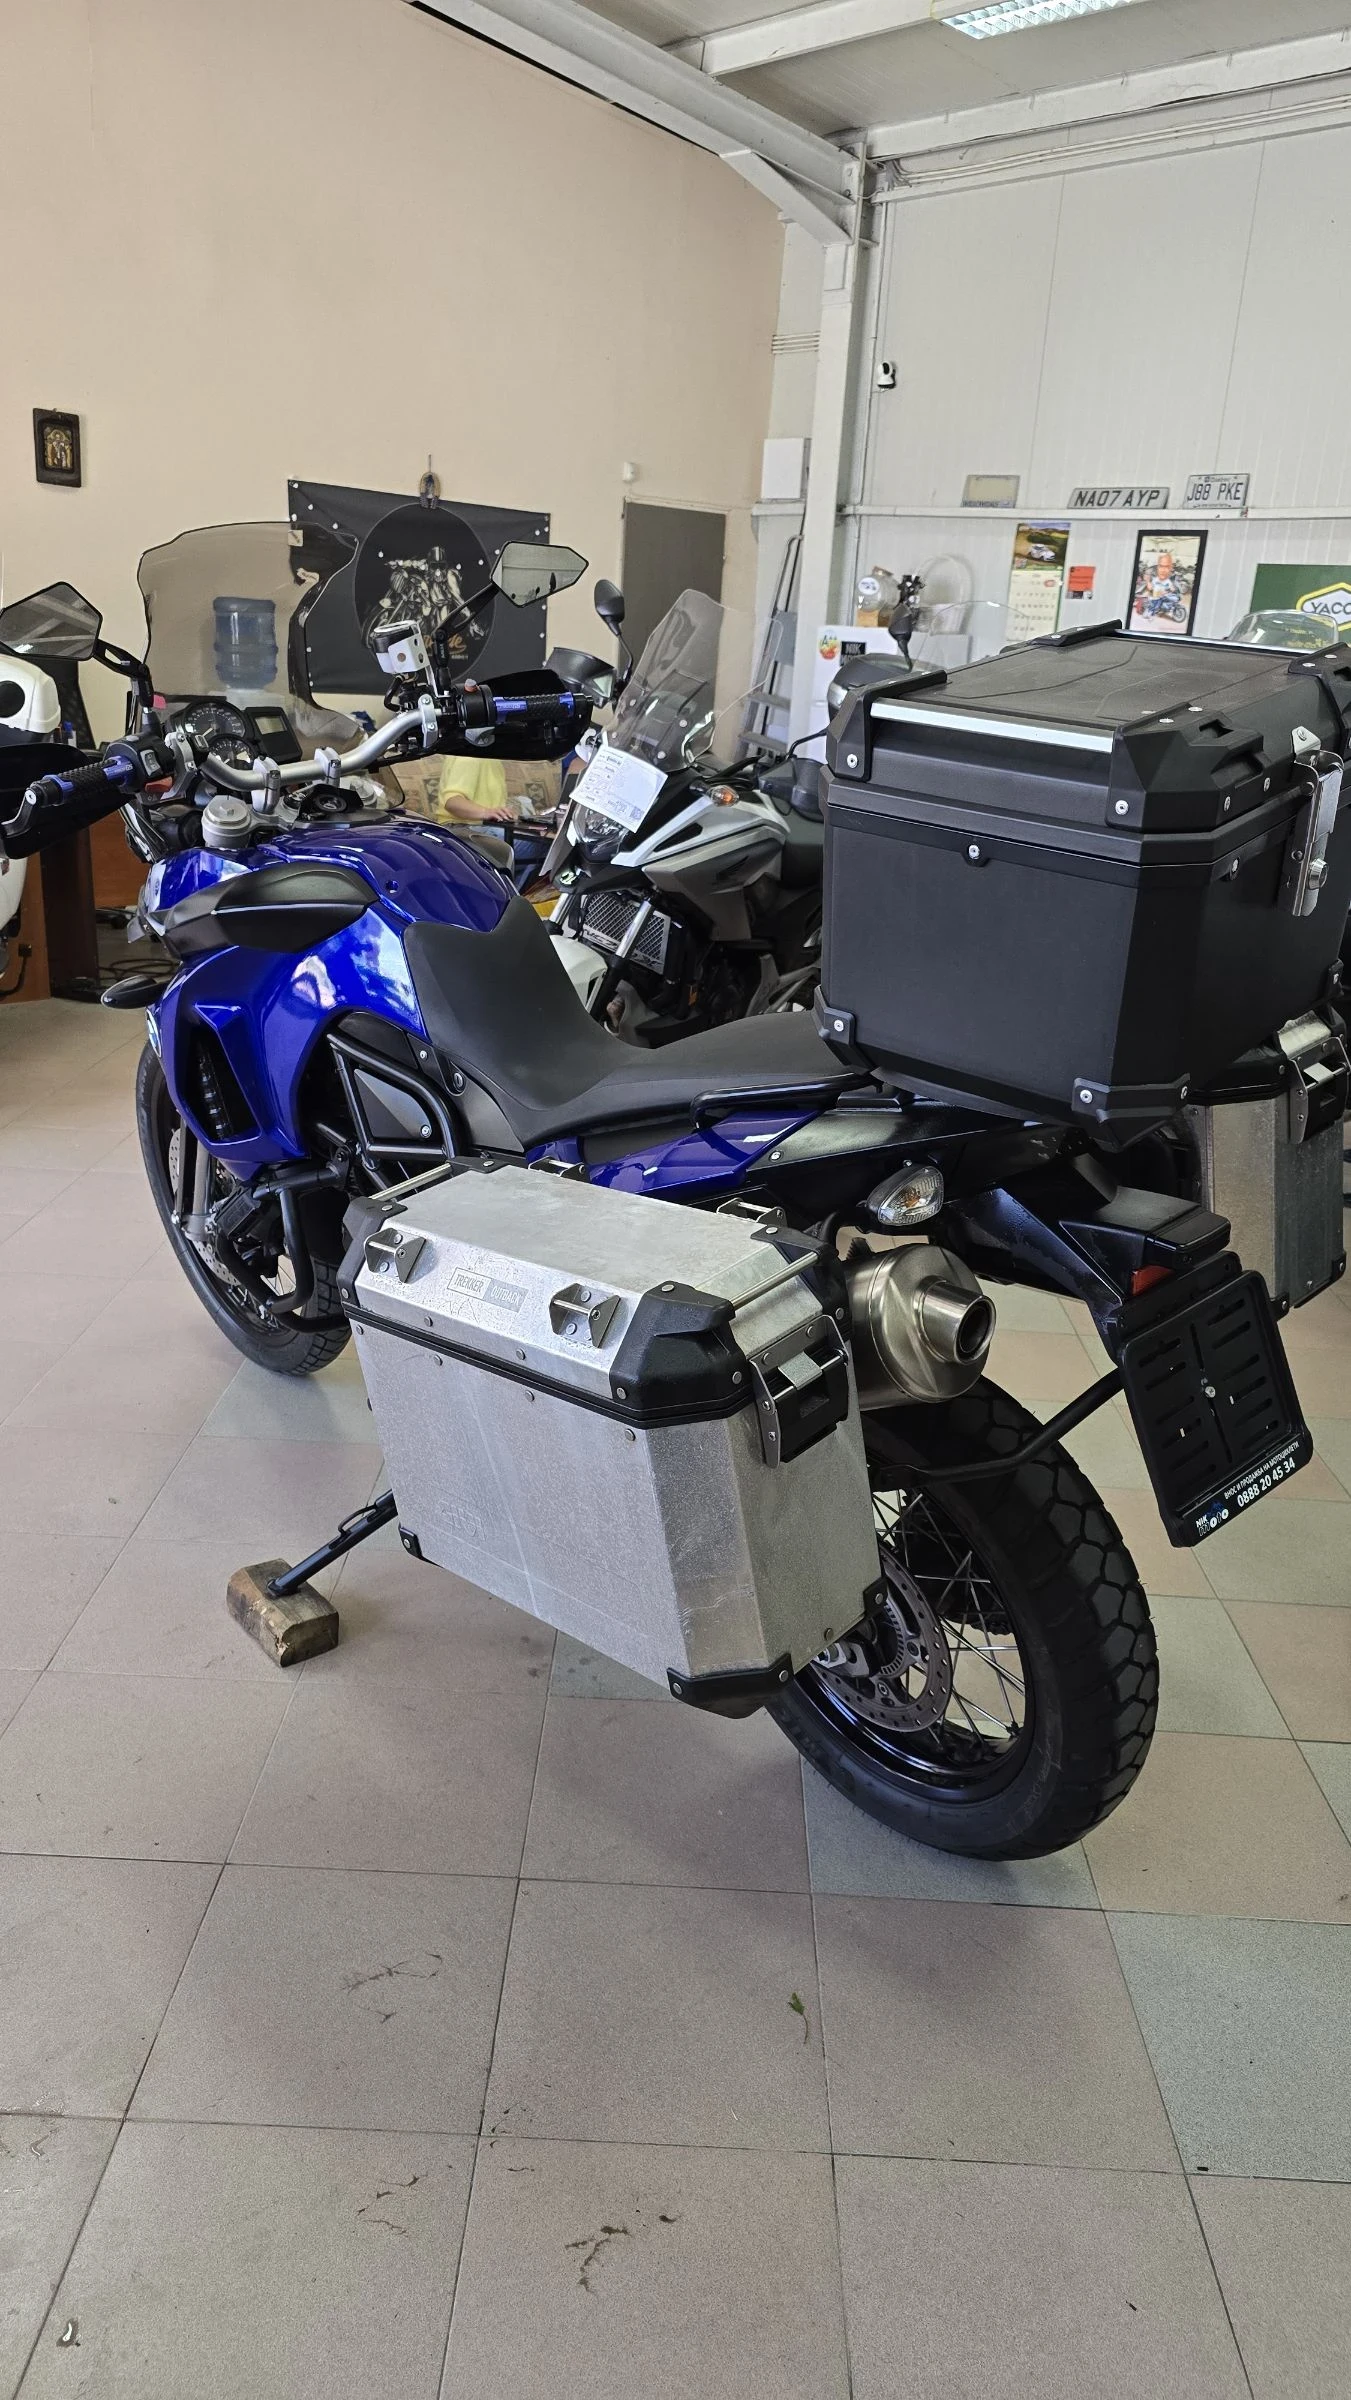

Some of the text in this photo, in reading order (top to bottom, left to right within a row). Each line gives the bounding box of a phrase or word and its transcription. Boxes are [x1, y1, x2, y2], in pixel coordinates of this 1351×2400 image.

[1074, 489, 1161, 507] NA07 AYP
[1187, 482, 1244, 502] J88 PKE
[454, 1273, 521, 1307] TREKKER OUTBACK
[1223, 1441, 1300, 1500] ВНОС И ПРОДАЖБА НА МОТОЦИКЛЕТИ
[1237, 1457, 1296, 1508] 0888 20 45 34
[1195, 1514, 1208, 1528] NIK
